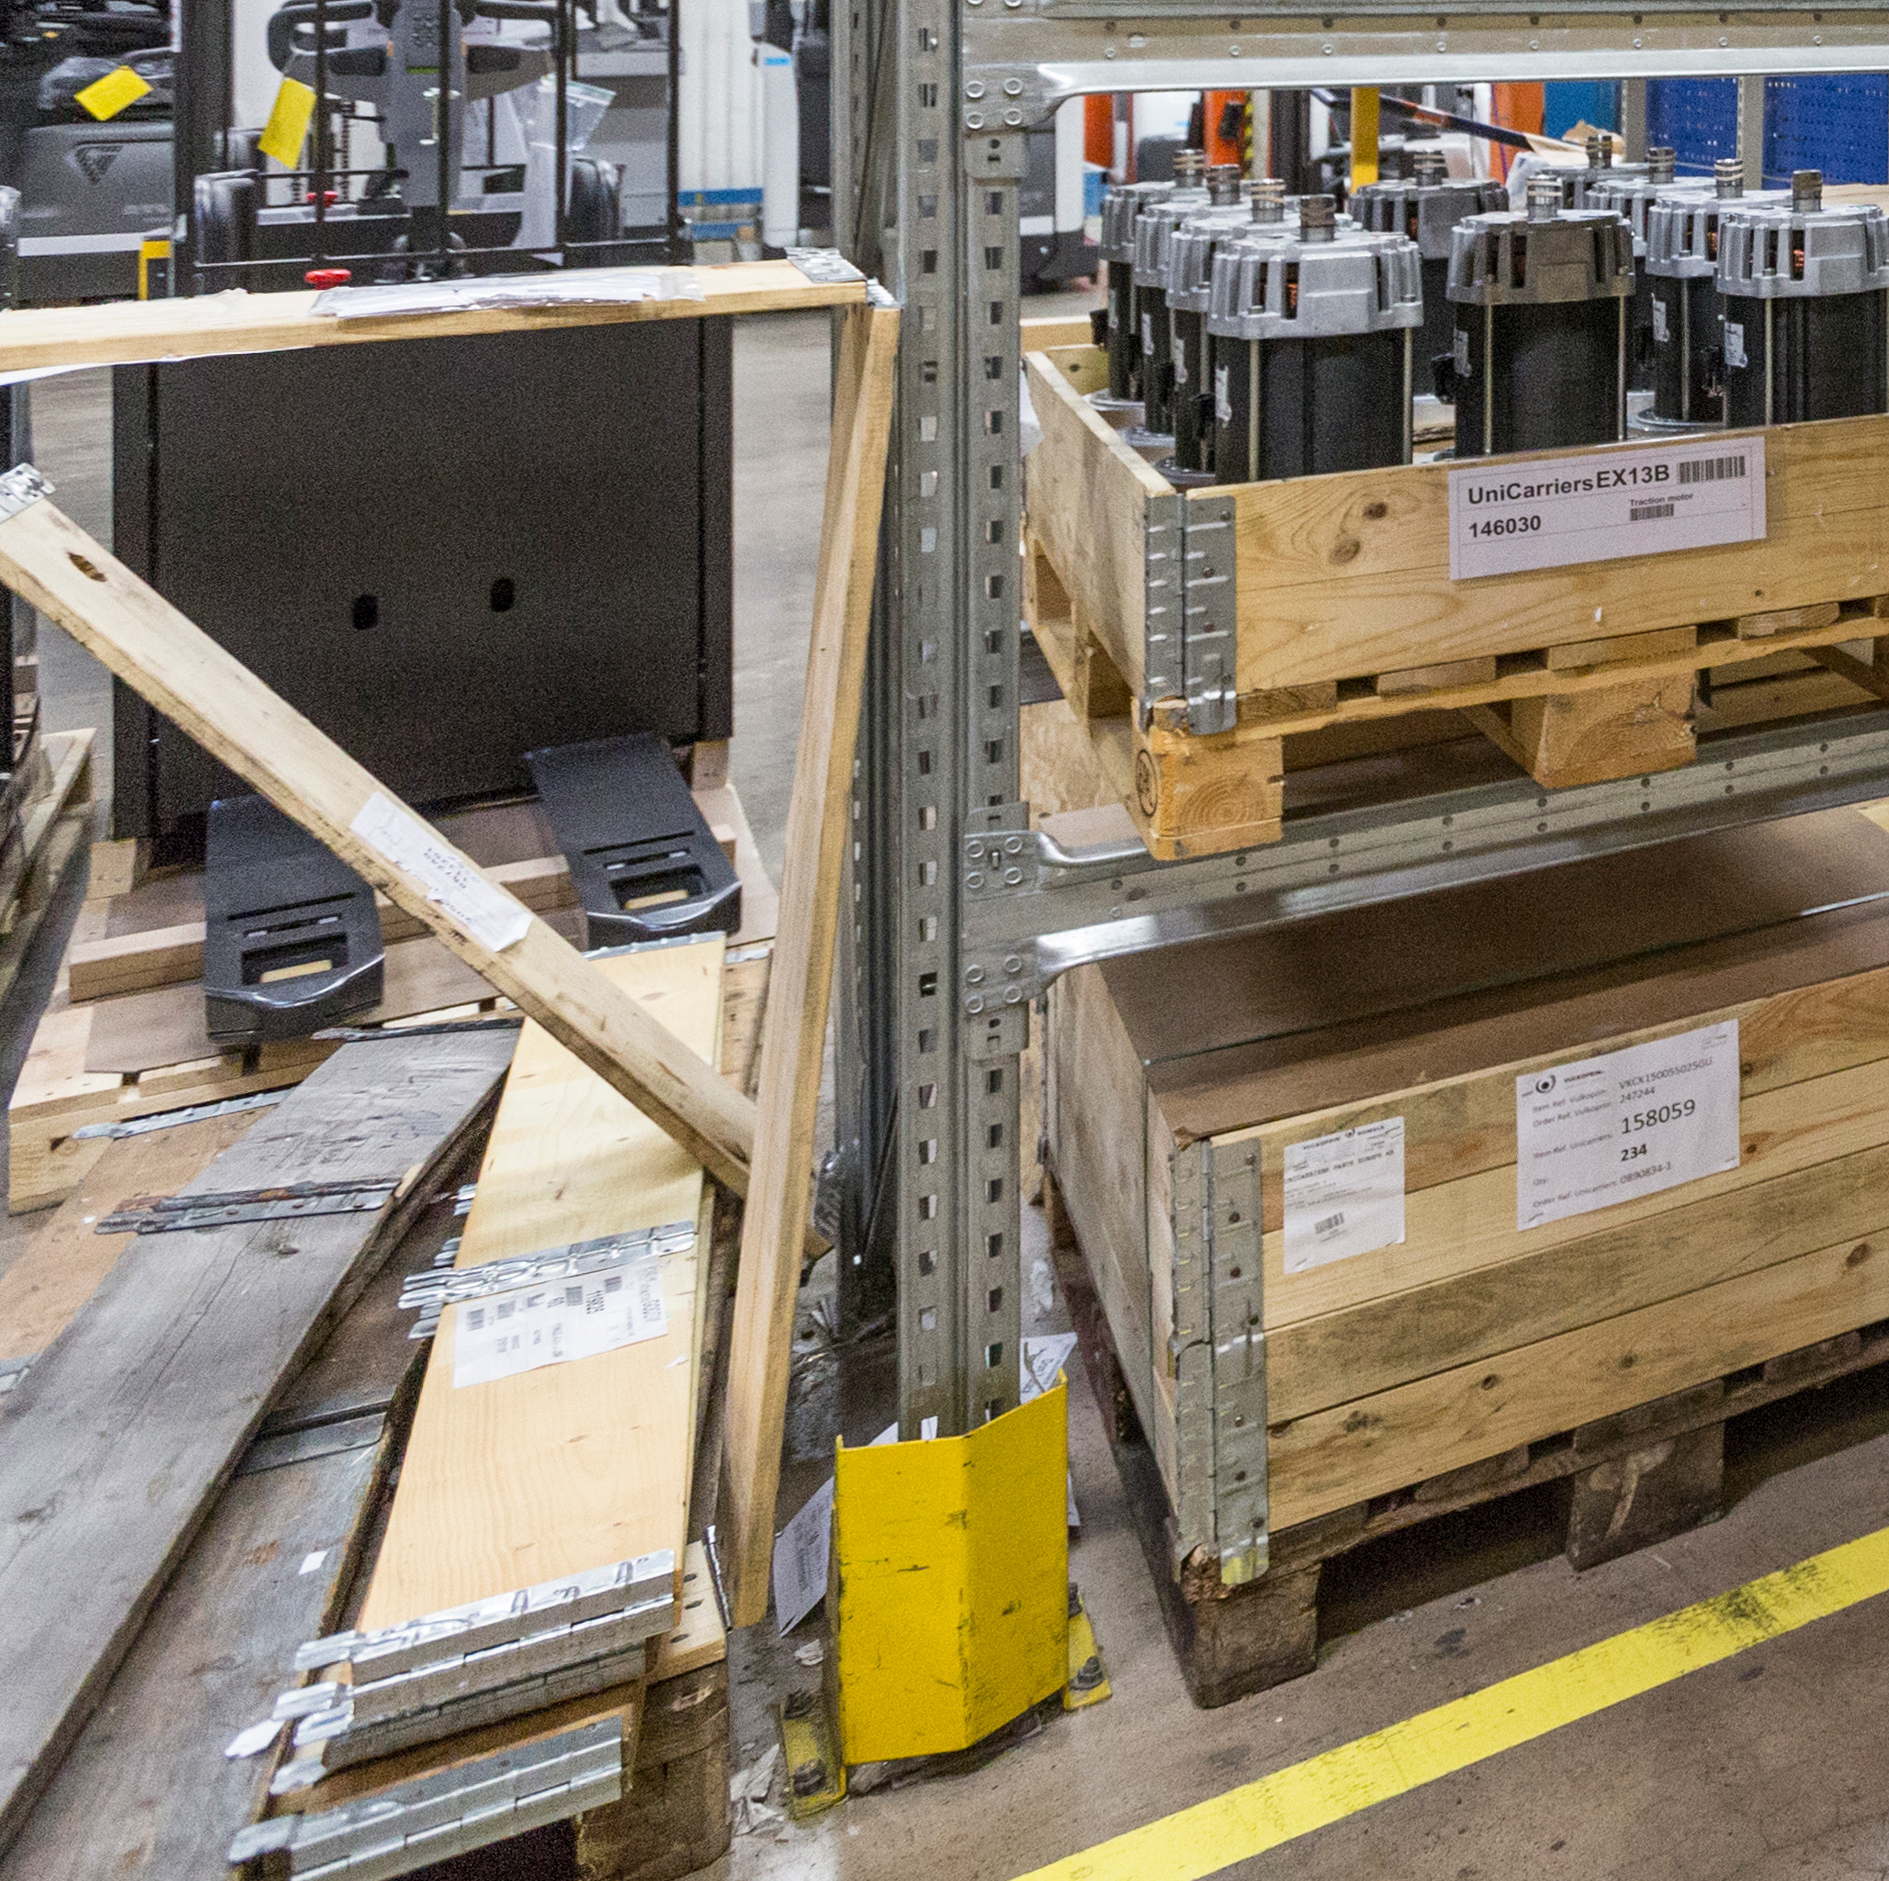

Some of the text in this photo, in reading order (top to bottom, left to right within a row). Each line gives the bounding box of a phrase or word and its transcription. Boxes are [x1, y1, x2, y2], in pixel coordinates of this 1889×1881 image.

[1468, 464, 1670, 505] UniCarriers EX13B
[1629, 492, 1694, 508] Traction motor
[1468, 515, 1542, 539] 146030
[1621, 1098, 1696, 1135] 158059
[1620, 1143, 1649, 1162] 234
